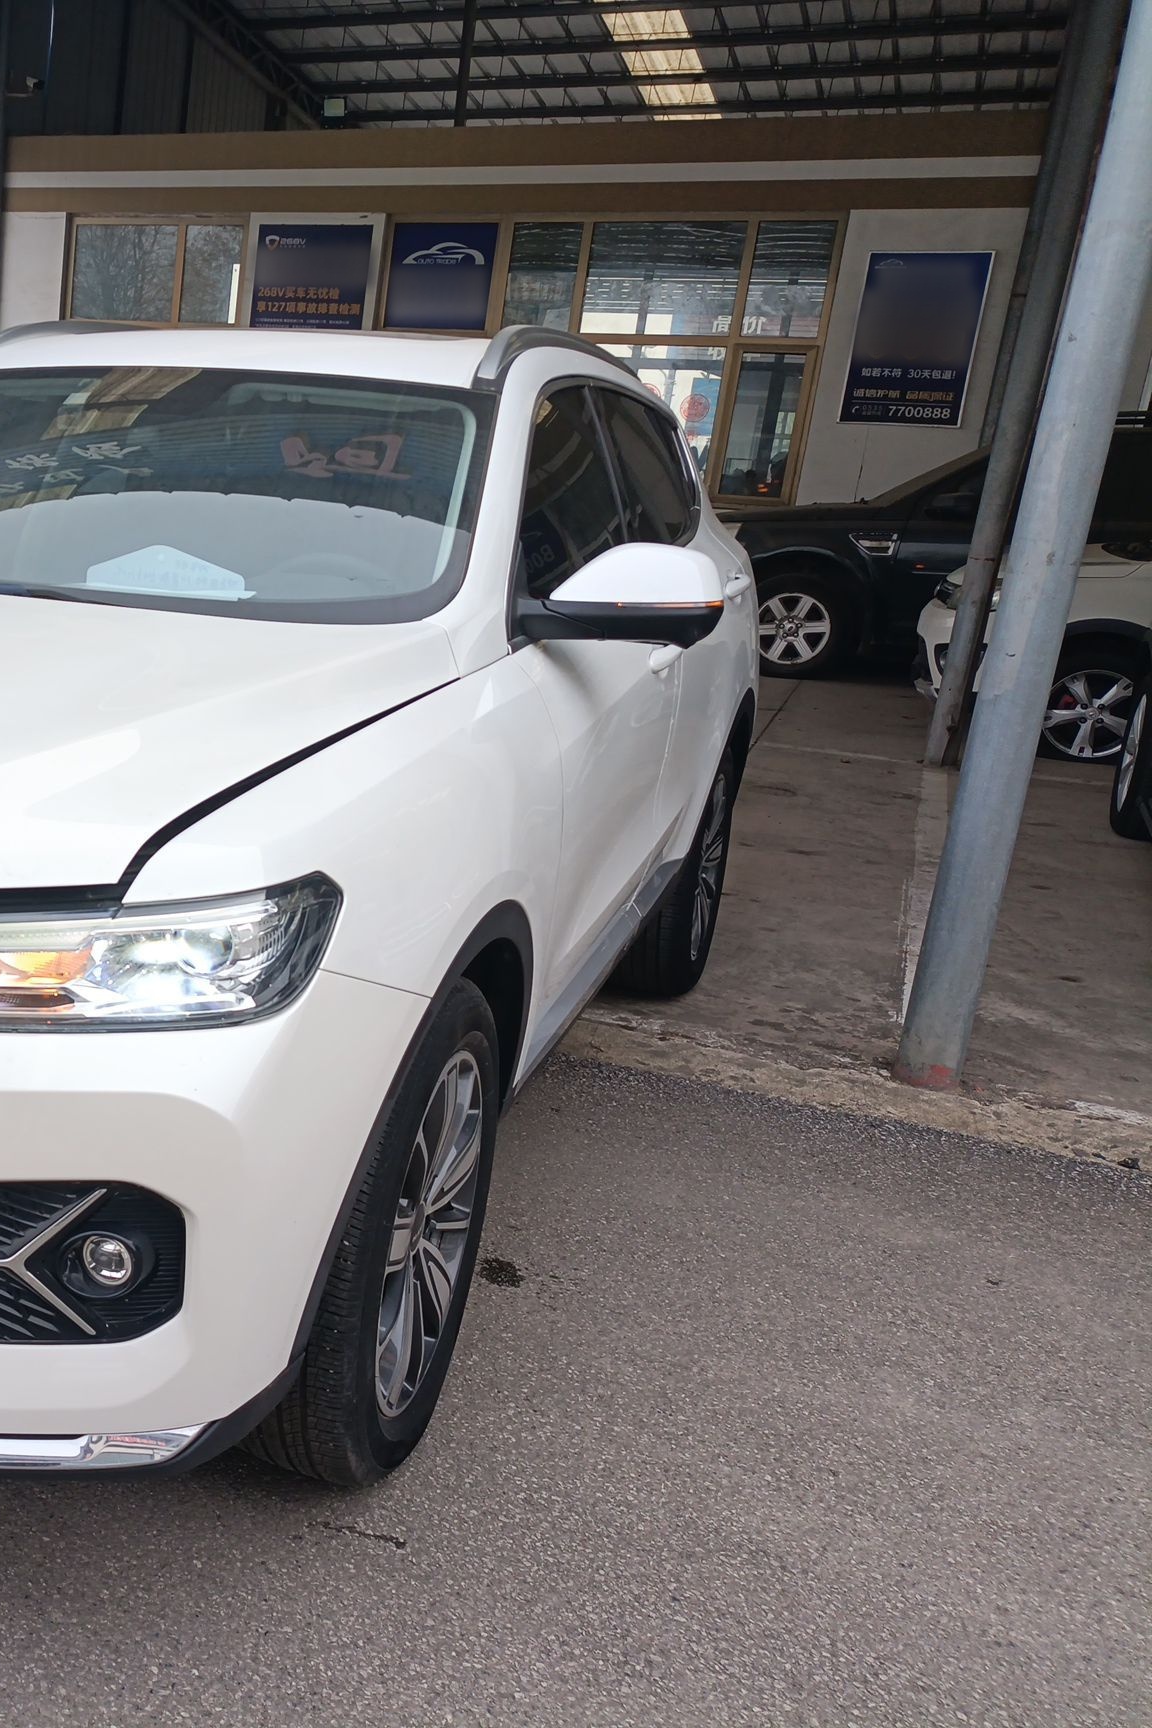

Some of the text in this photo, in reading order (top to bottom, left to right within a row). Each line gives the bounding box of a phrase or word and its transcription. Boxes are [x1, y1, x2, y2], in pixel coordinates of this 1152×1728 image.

[861, 367, 903, 379] 如若不符
[888, 405, 951, 419] 7700888
